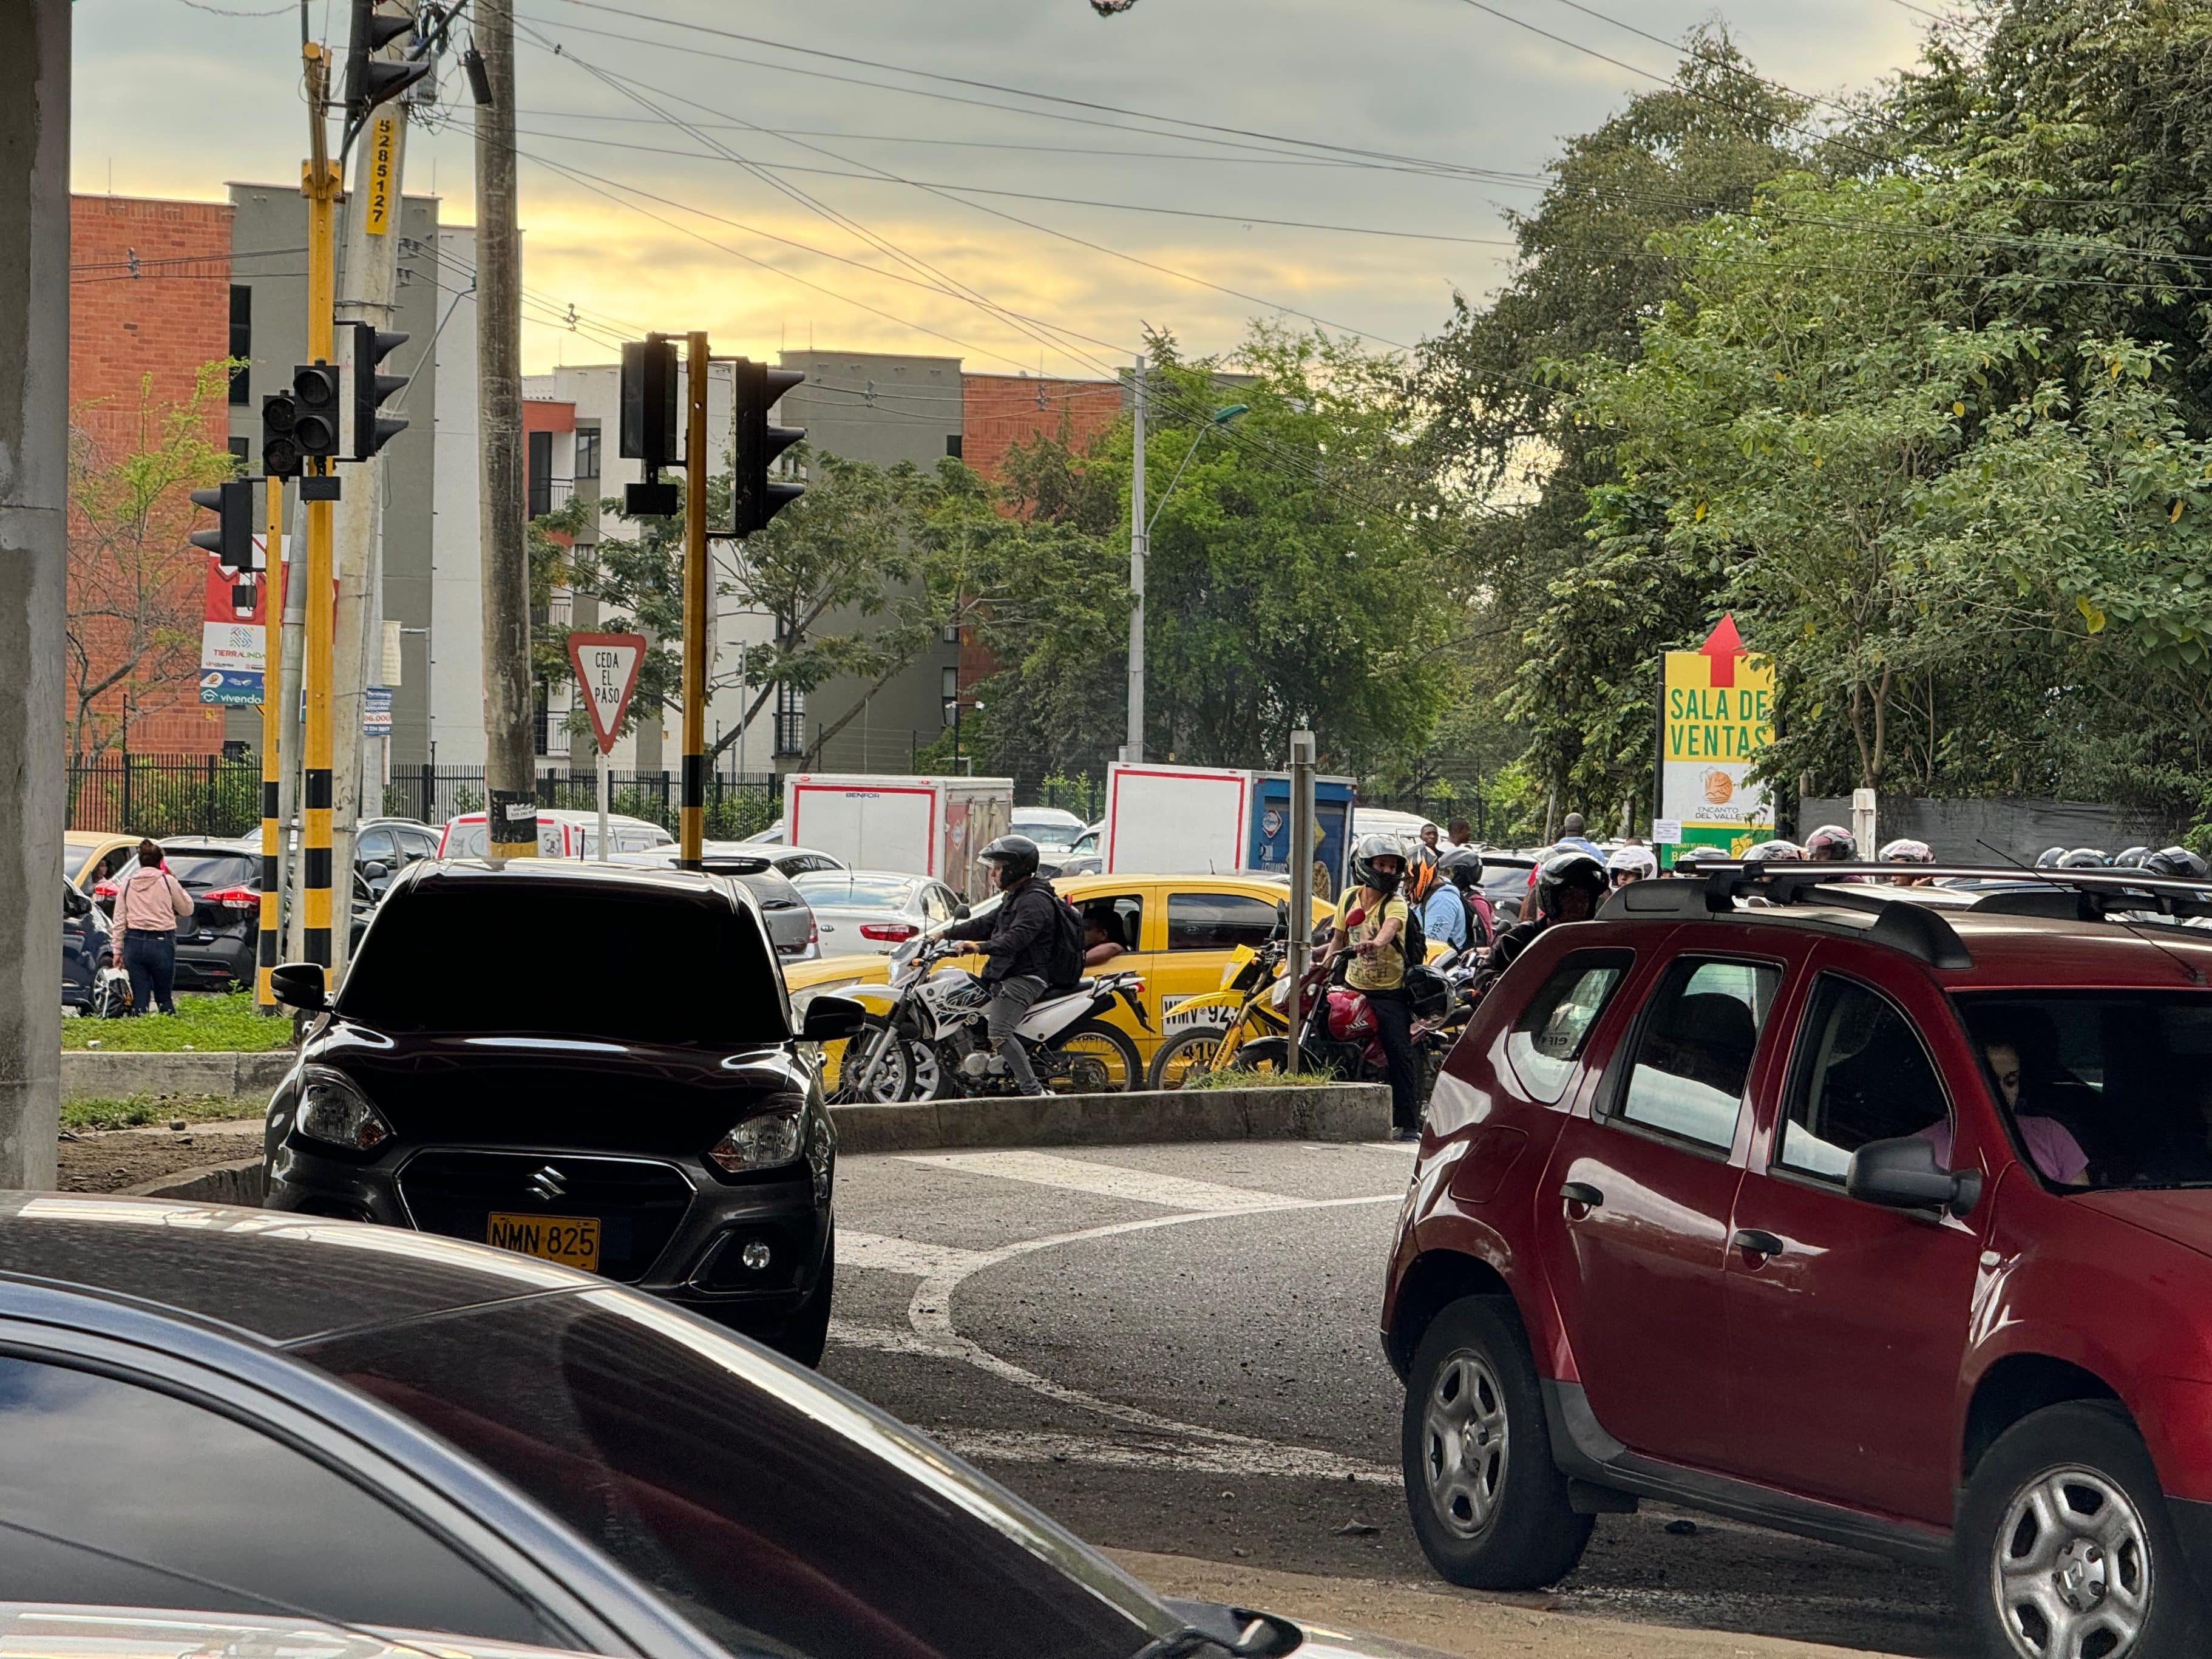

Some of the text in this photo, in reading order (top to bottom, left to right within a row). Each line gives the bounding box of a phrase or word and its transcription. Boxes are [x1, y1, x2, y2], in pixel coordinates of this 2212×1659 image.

[373, 119, 390, 223] 5285127
[595, 652, 619, 668] CEDA
[602, 670, 612, 686] EL
[595, 687, 619, 704] PASO
[1671, 688, 1768, 721] SALA DE
[1671, 724, 1767, 757] VENTAS
[492, 1223, 595, 1256] NMN 825
